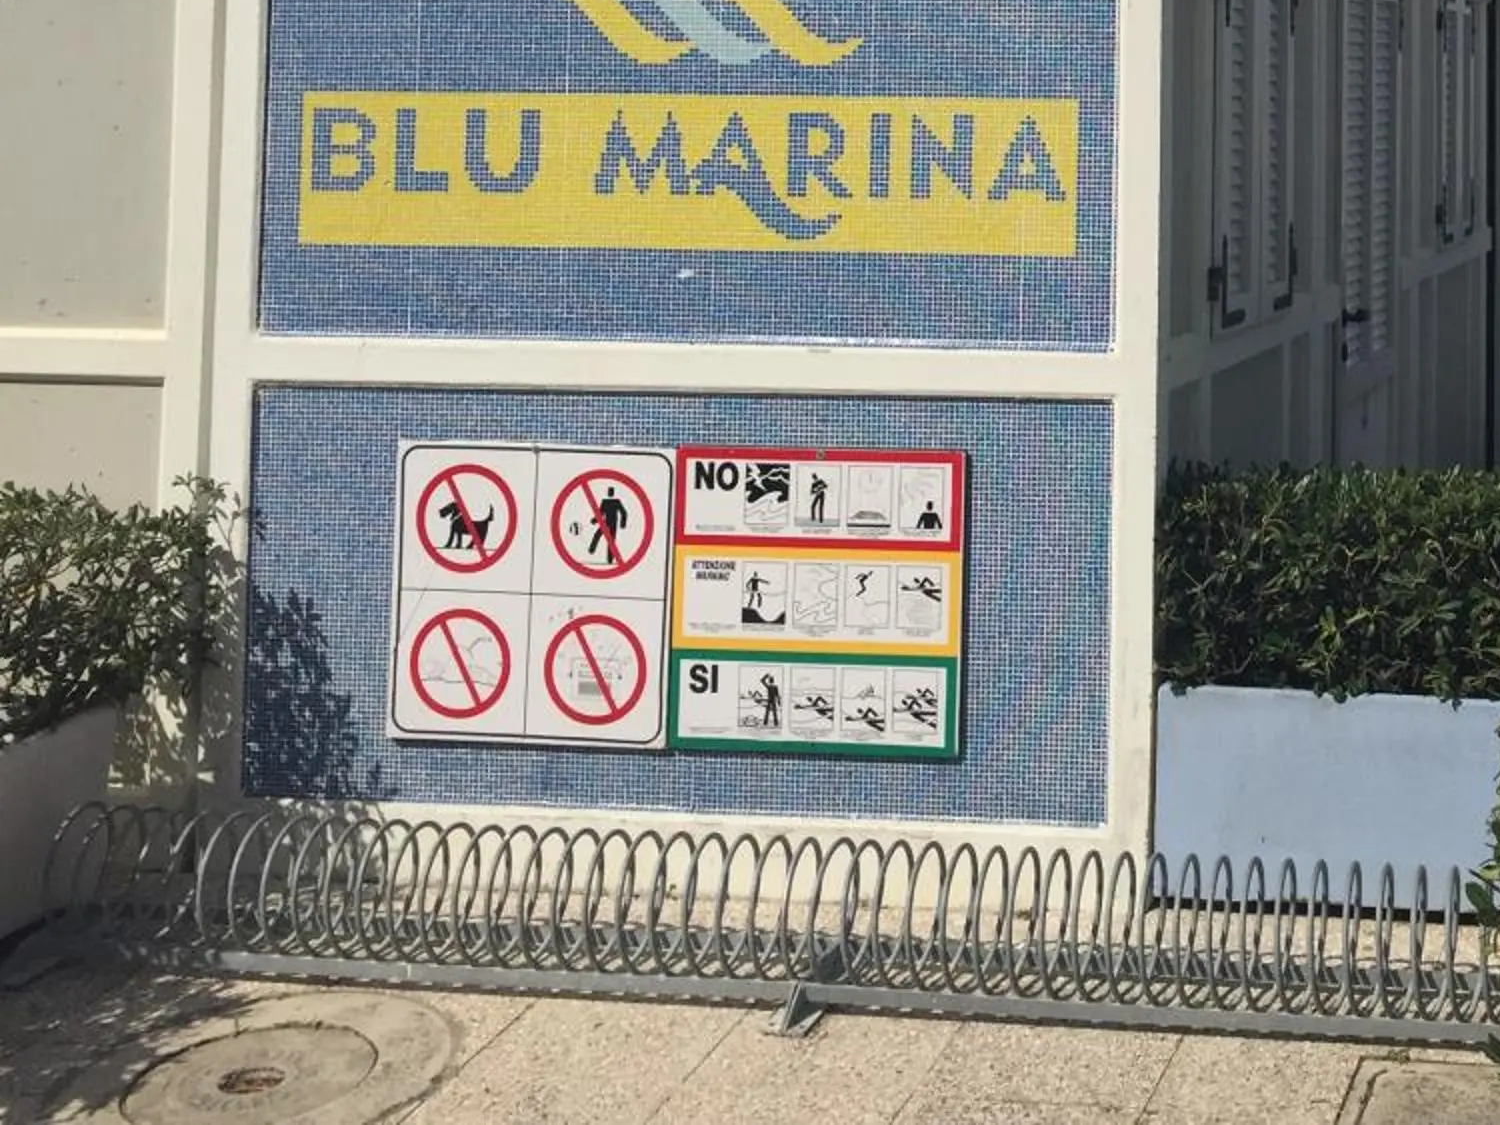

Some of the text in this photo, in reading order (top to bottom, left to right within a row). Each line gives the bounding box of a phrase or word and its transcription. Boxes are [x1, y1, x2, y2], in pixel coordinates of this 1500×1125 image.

[311, 107, 1067, 242] BLU MARINA
[694, 461, 740, 492] NO
[689, 664, 719, 694] SI
